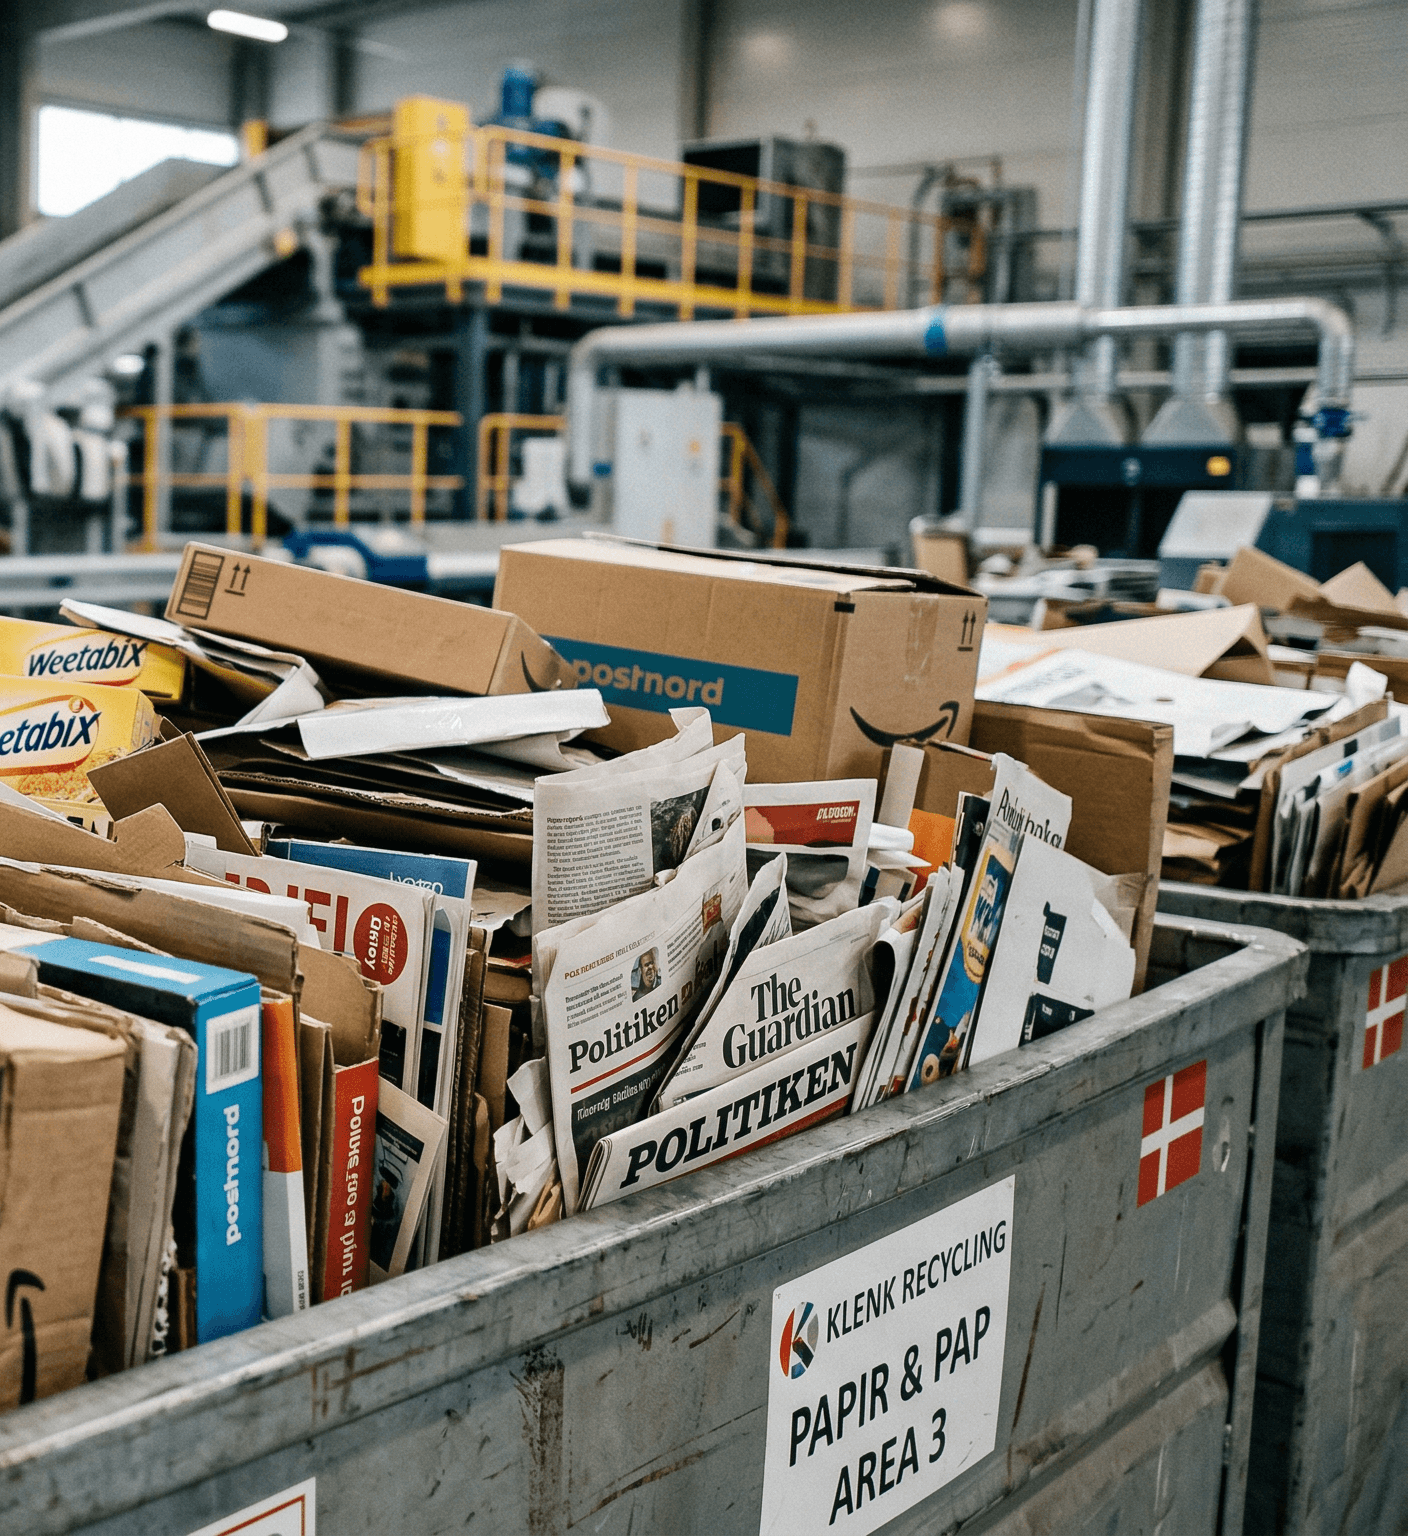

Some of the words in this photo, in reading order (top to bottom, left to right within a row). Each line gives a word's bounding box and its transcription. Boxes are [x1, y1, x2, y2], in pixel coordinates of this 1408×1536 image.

[28, 637, 149, 677] Weetabix
[572, 659, 725, 706] postnord
[568, 993, 680, 1074] Politiken
[722, 988, 857, 1069] Guardian
[750, 972, 802, 1024] The
[619, 1041, 858, 1190] POLITIKEN
[826, 1275, 897, 1343] KLENK
[902, 1220, 1006, 1304] RECYCLING
[789, 1362, 890, 1467] PAPIR
[900, 1344, 923, 1402] &
[934, 1305, 991, 1383] PAP
[829, 1426, 920, 1526] AREA
[928, 1407, 947, 1464] 3
